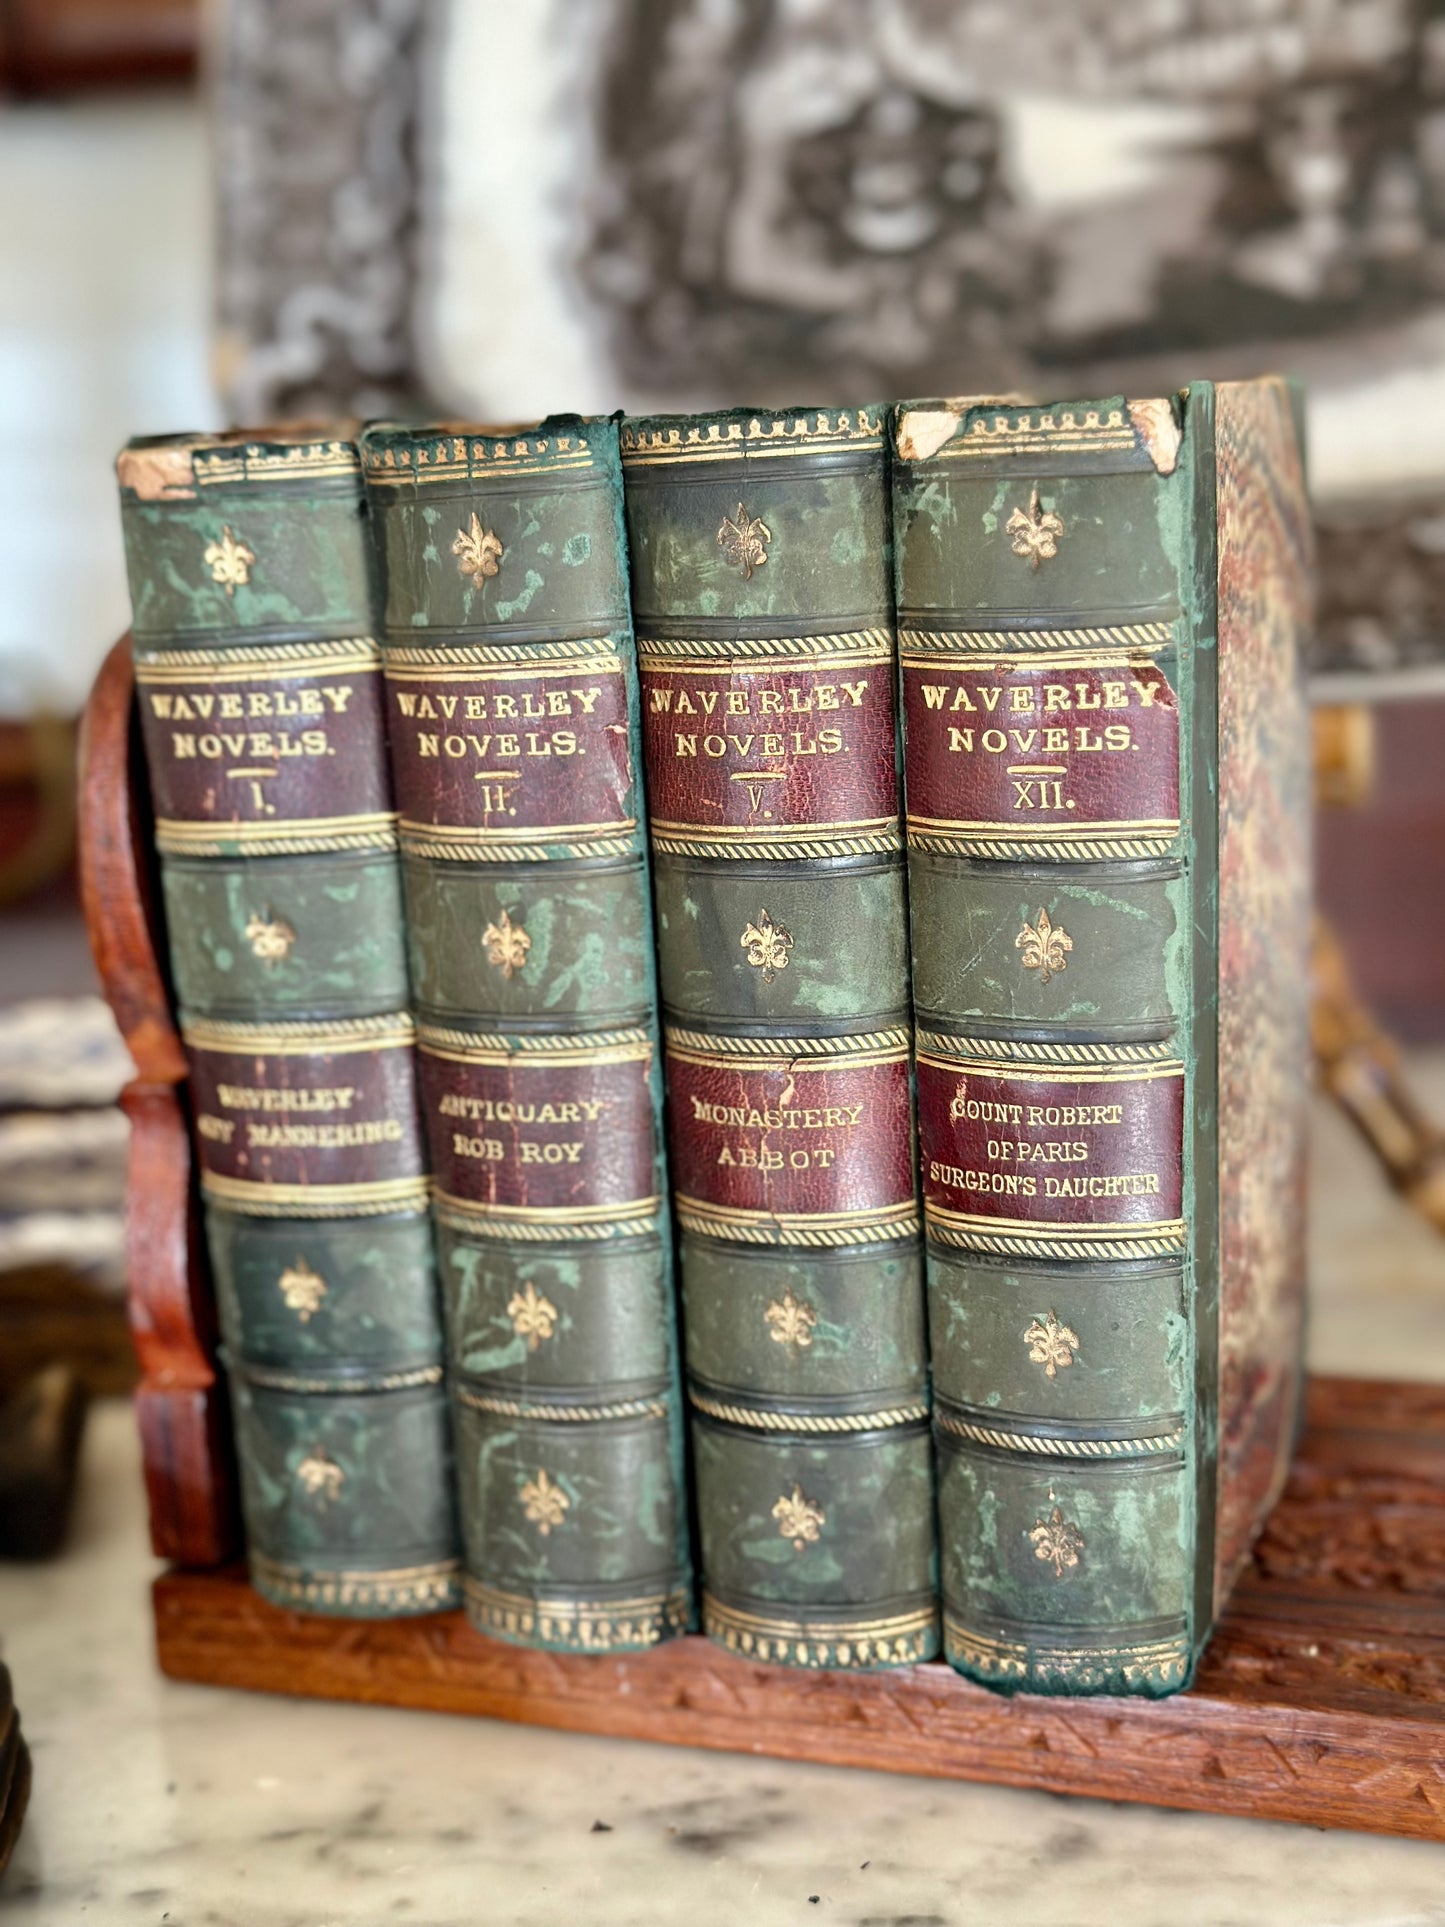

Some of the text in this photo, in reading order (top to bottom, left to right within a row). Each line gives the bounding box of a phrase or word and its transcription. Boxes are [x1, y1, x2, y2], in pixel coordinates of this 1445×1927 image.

[151, 686, 353, 720] WAVERLEY
[397, 687, 602, 719] WAVERLEY
[651, 680, 869, 715] WAVERLEY
[921, 681, 1160, 712] WAVERLEY
[172, 730, 337, 758] NOVELS.
[417, 731, 586, 758] NOVELS.
[675, 728, 850, 757] NOVELS.
[947, 725, 1140, 753] NOVELS.
[482, 785, 517, 816] II.
[747, 785, 772, 818] V.
[1012, 781, 1076, 809] XII.
[690, 1095, 864, 1129] MONASTERY
[952, 1098, 1123, 1126] COUNT ROBERT
[453, 1133, 584, 1163] ROB ROY
[717, 1147, 835, 1170] ABBOT
[987, 1140, 1088, 1162] OF PARIS
[930, 1161, 1160, 1198] SURGEON'S DAUGHTER
